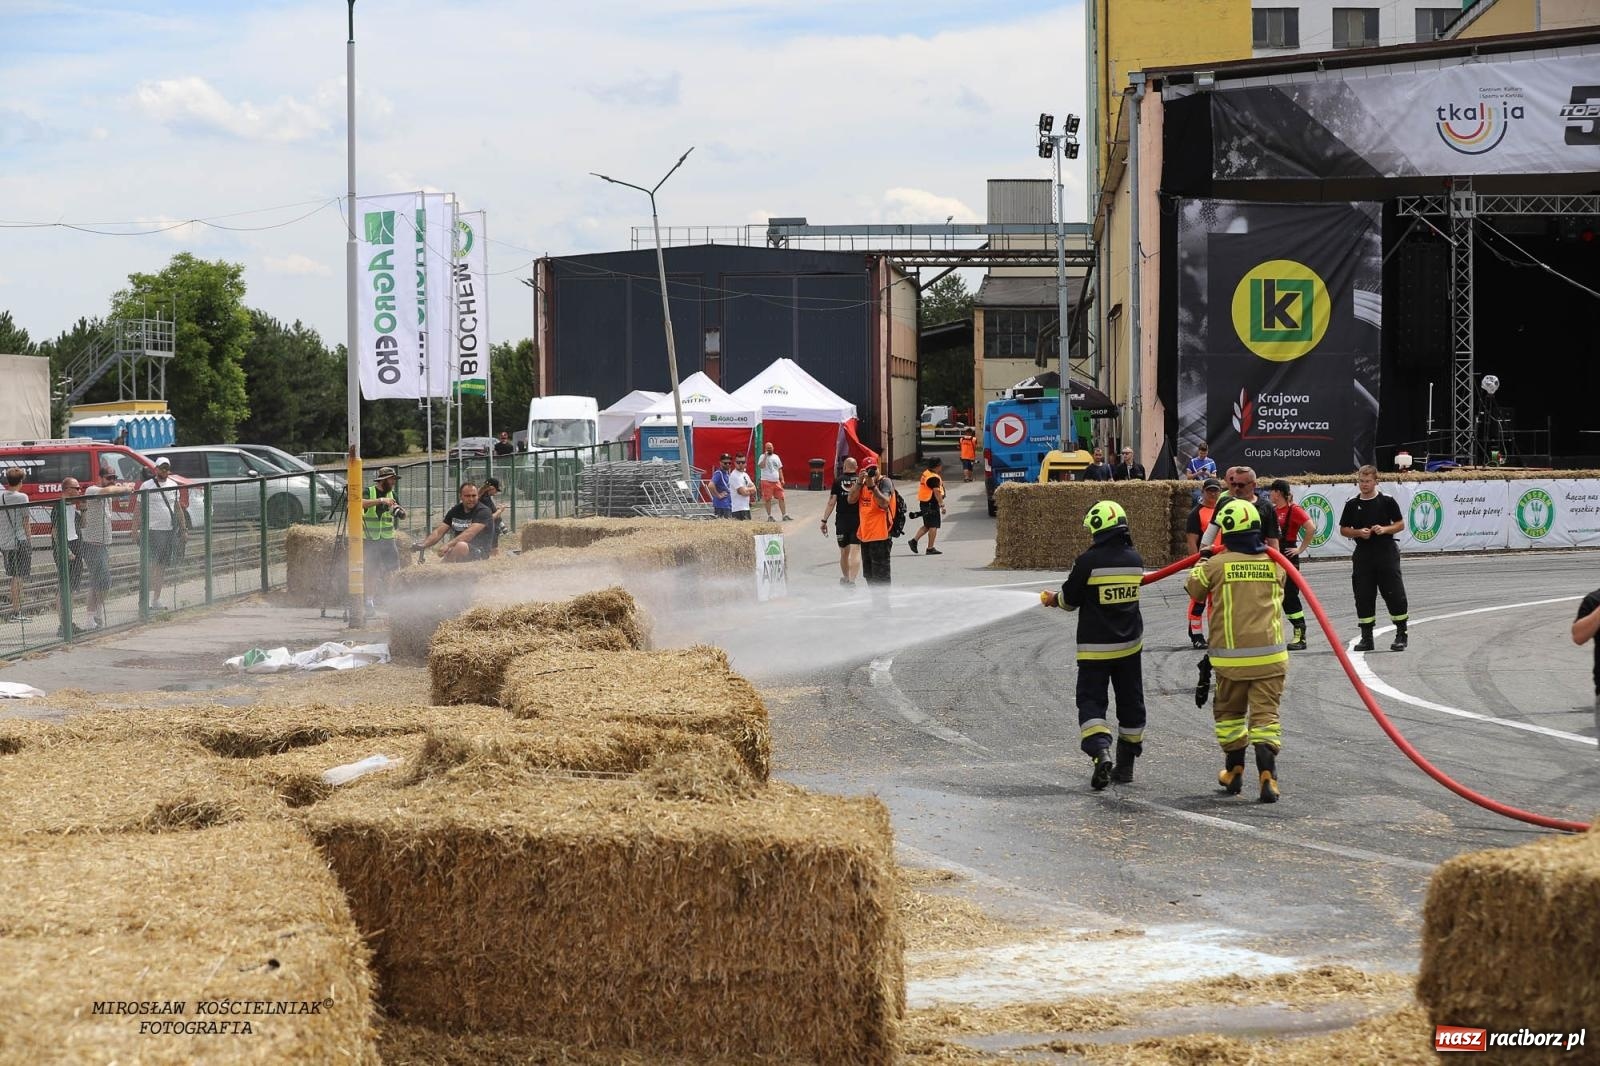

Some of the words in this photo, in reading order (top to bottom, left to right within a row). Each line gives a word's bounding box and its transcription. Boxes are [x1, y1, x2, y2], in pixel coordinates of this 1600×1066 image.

[1258, 393, 1310, 405] Krajowa
[1258, 406, 1298, 419] Grupa
[1258, 419, 1330, 432] Spożywcza
[1244, 448, 1272, 459] Grupa
[1273, 448, 1321, 459] Kapitałowa
[38, 484, 62, 493] STRA
[1231, 564, 1270, 572] OCHOTNICZA
